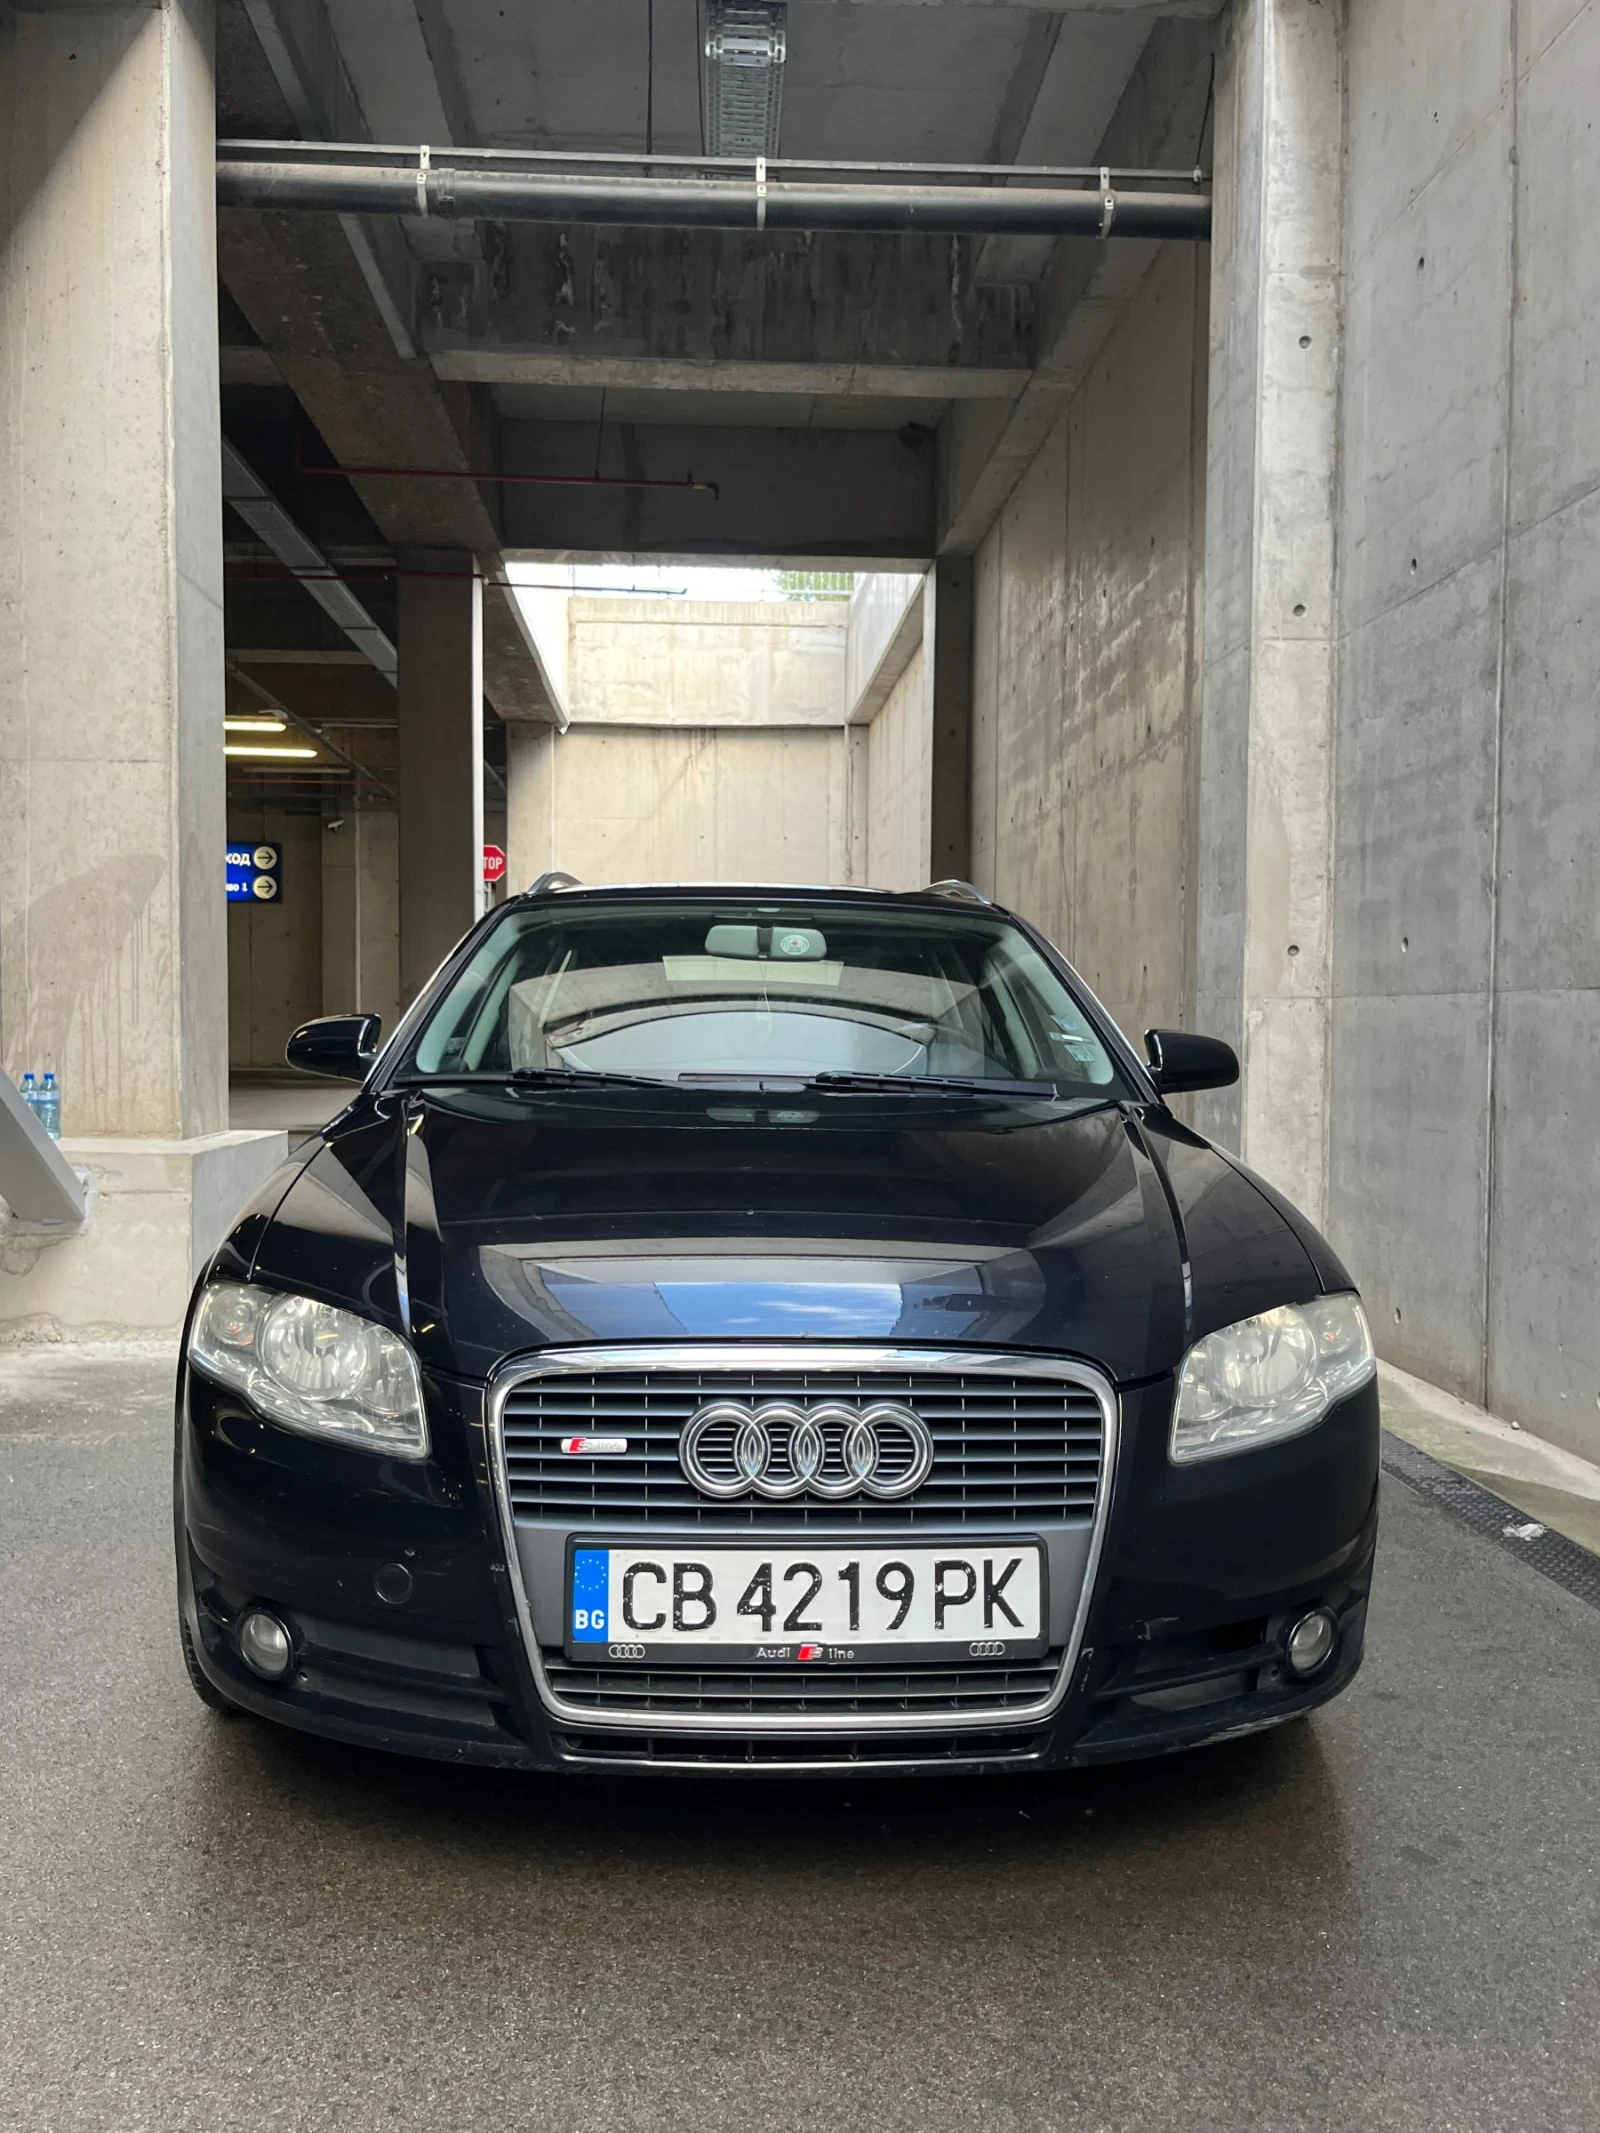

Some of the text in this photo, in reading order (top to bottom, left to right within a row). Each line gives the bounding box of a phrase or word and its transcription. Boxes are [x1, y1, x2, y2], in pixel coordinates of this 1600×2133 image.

[484, 857, 503, 870] TOP
[242, 882, 248, 892] 1
[622, 1558, 1025, 1632] CB 4219 PK
[575, 1609, 605, 1630] BG
[756, 1647, 791, 1658] Audi
[828, 1648, 855, 1659] line
